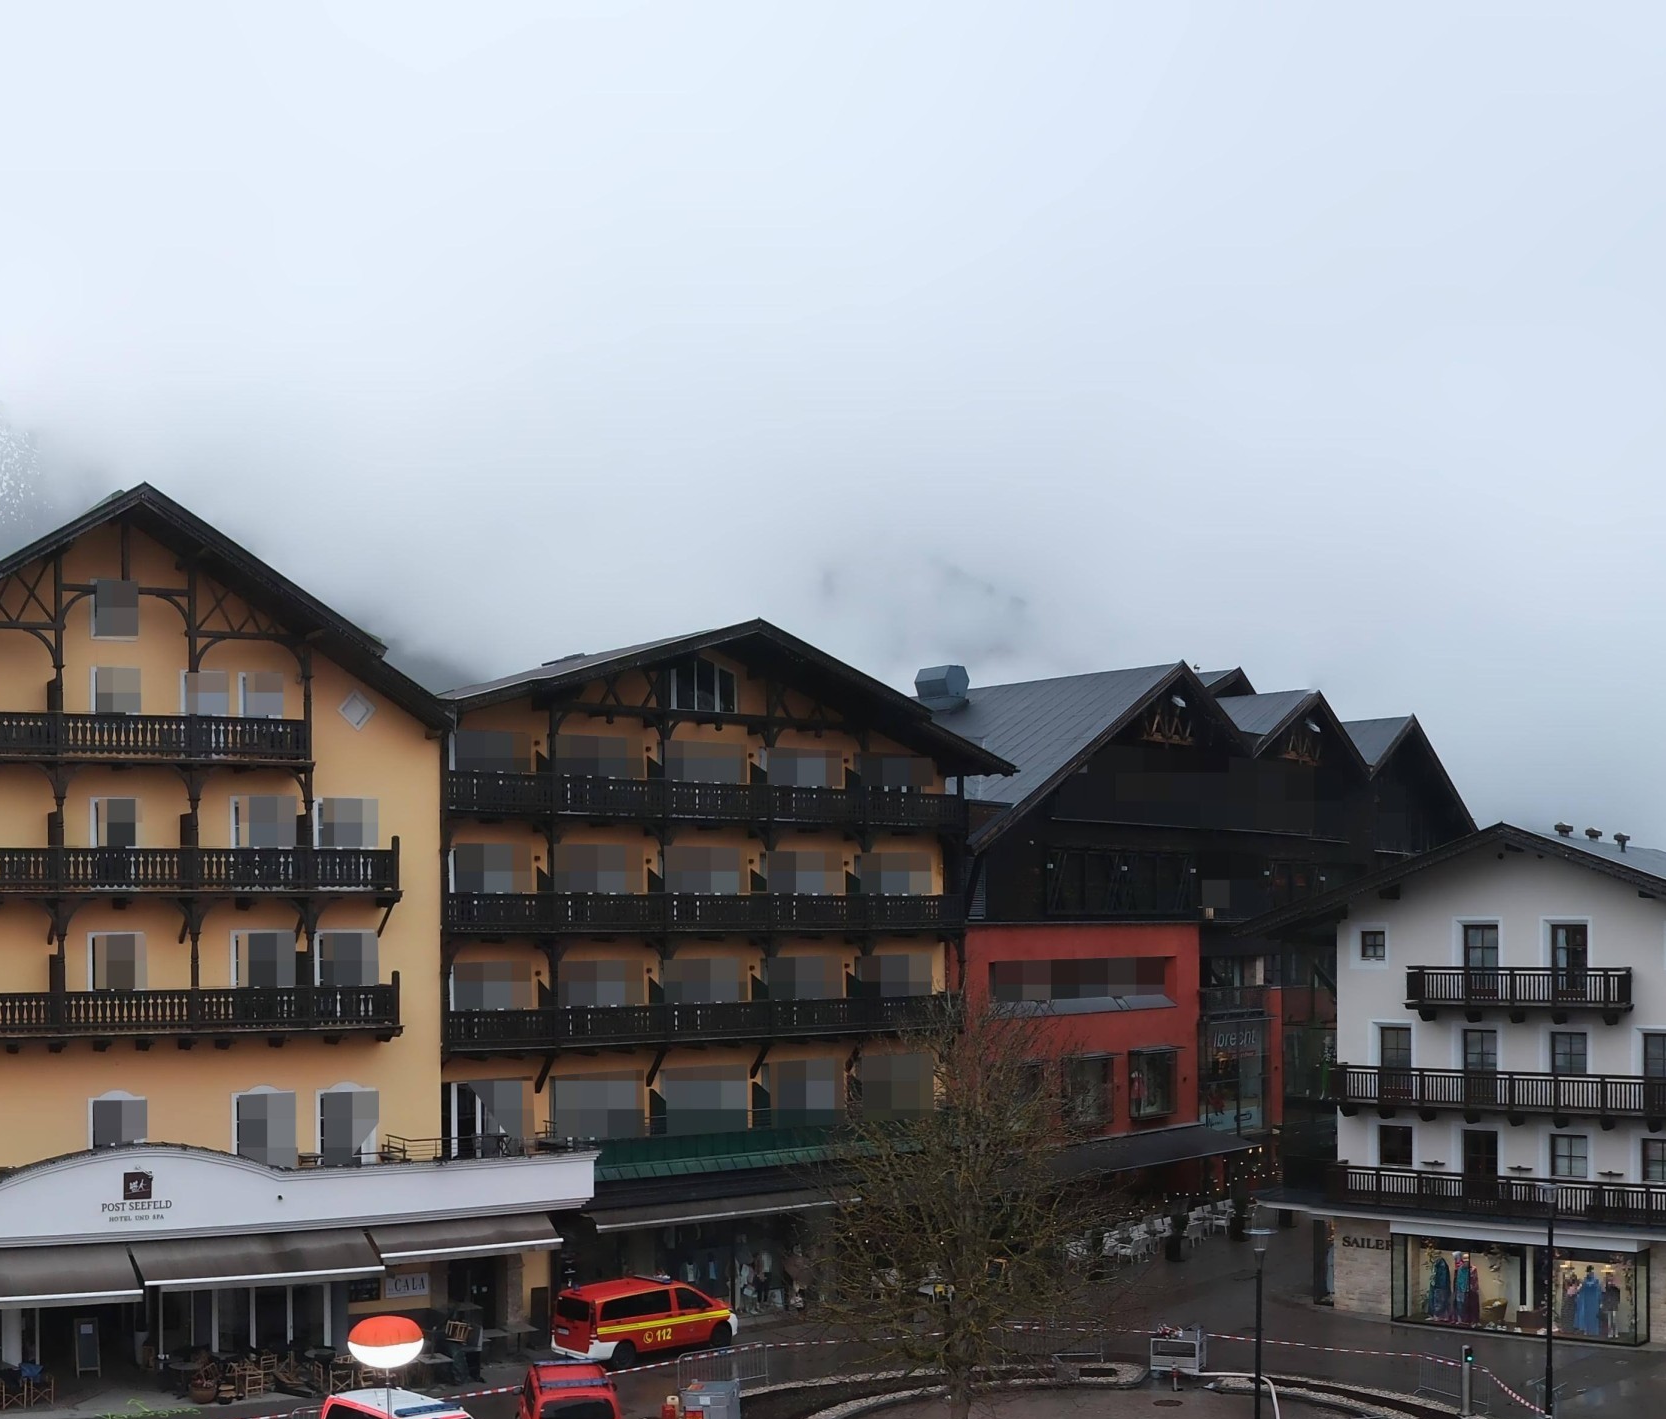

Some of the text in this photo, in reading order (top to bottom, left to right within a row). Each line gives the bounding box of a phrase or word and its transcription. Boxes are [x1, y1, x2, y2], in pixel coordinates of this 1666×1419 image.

[101, 1200, 173, 1212] POST SEEFELD
[655, 1327, 672, 1340] 112
